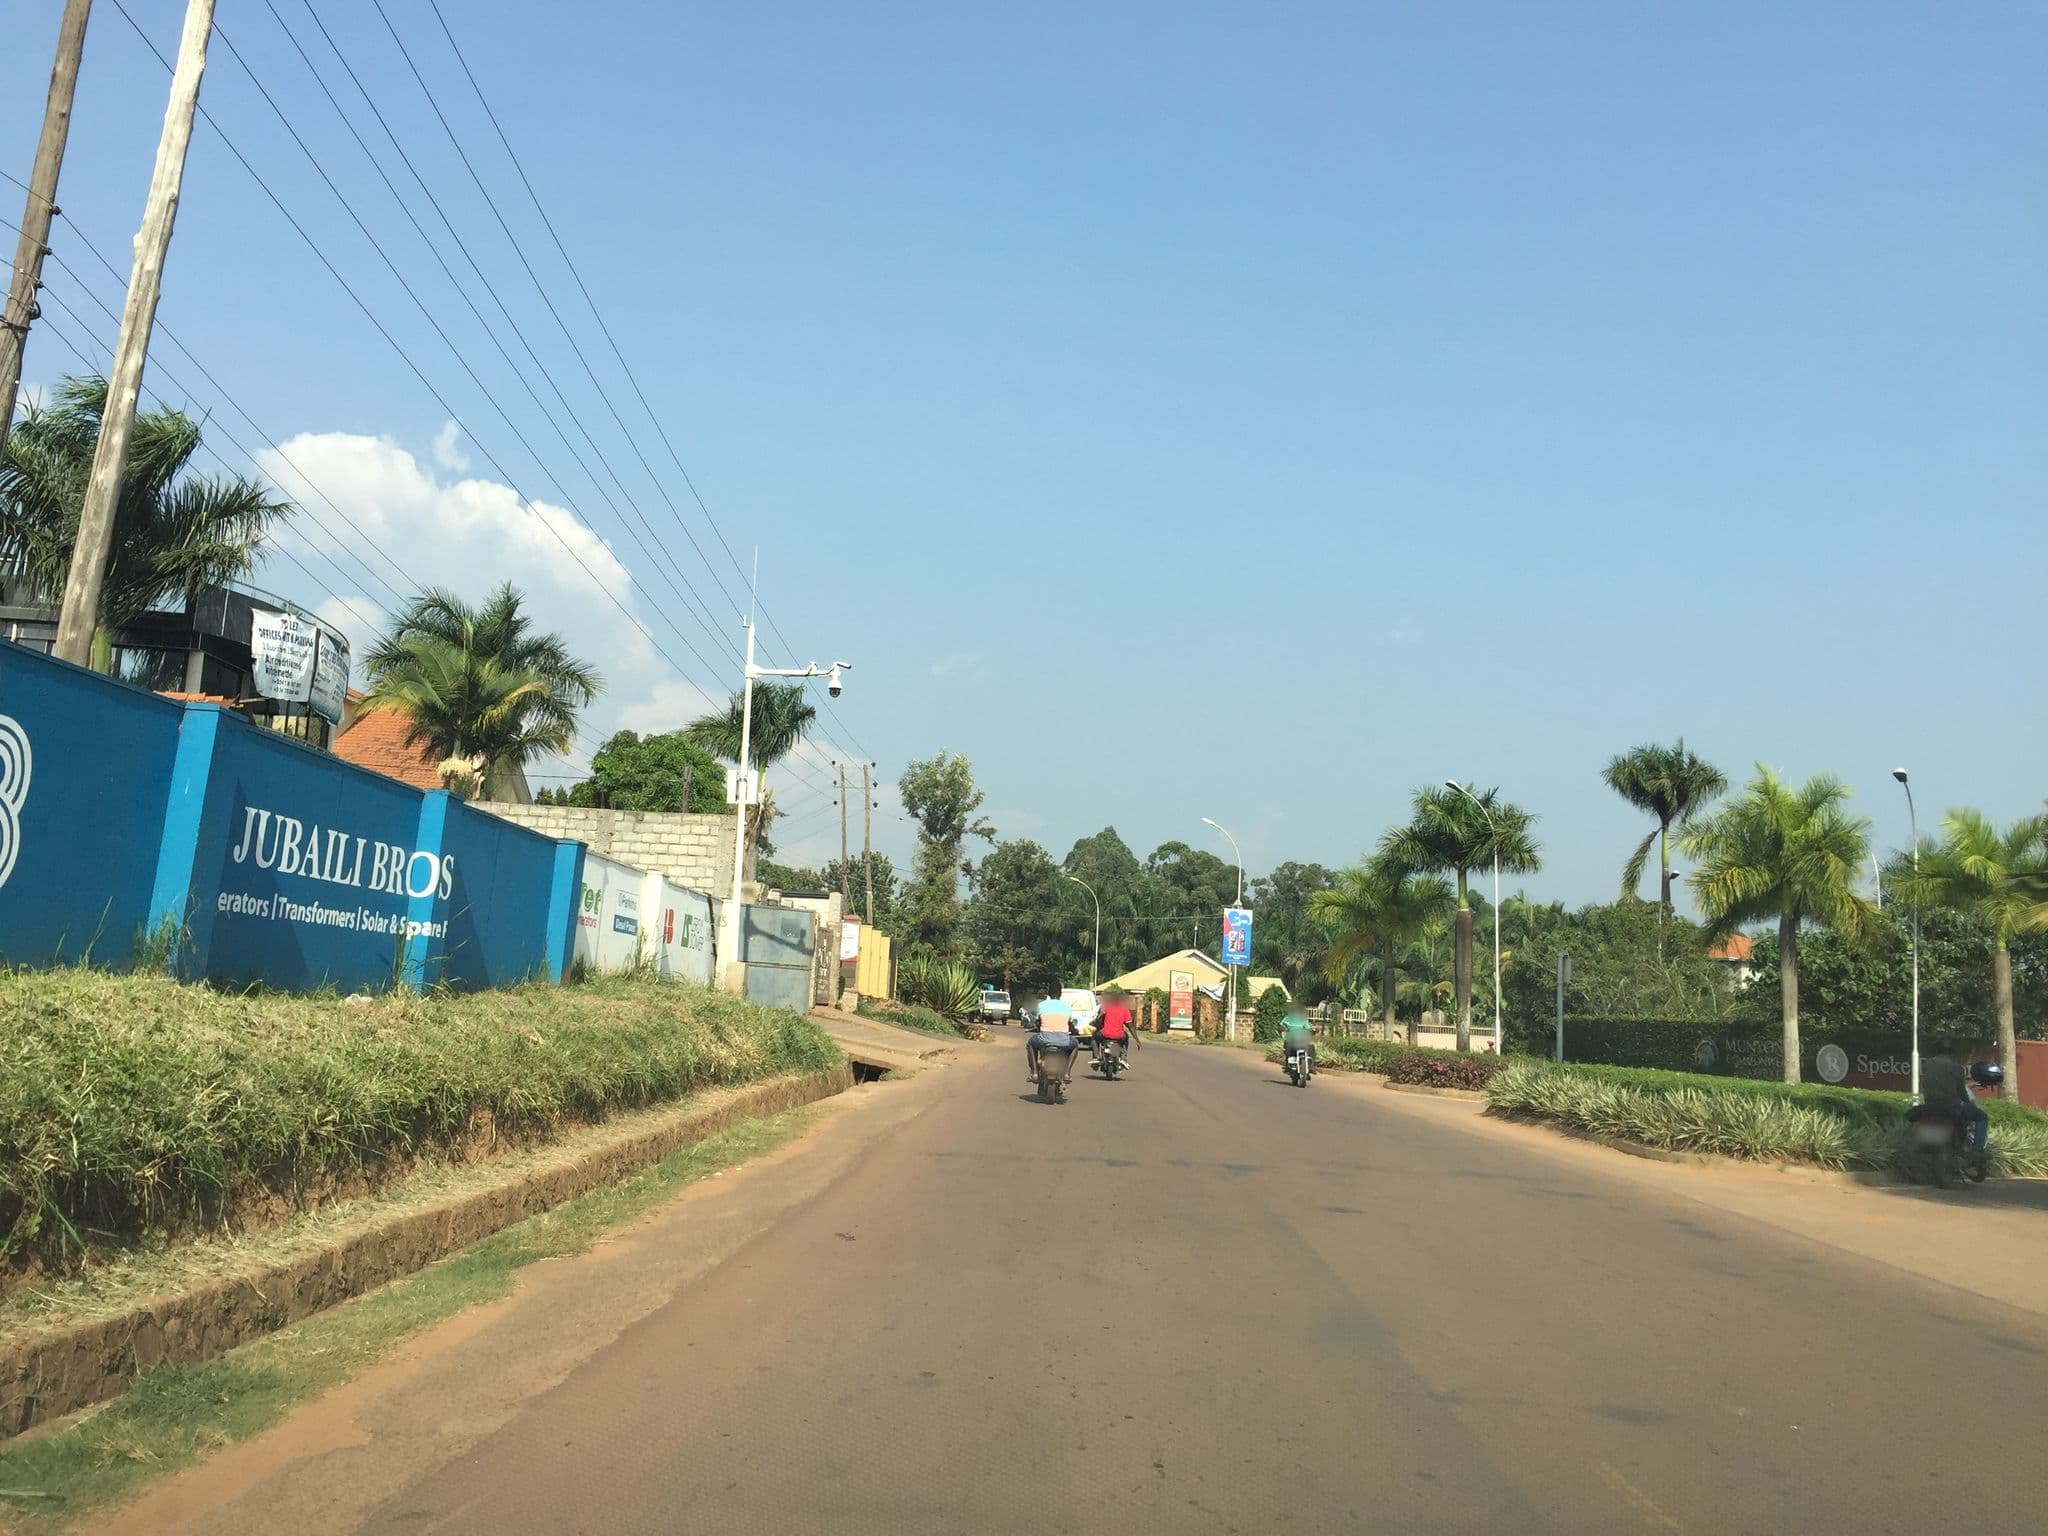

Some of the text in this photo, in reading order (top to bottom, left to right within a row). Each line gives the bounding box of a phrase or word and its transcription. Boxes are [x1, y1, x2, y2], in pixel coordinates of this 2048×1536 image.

[233, 806, 455, 900] JUBAILI BROS
[1856, 1053, 1911, 1079] Speke
